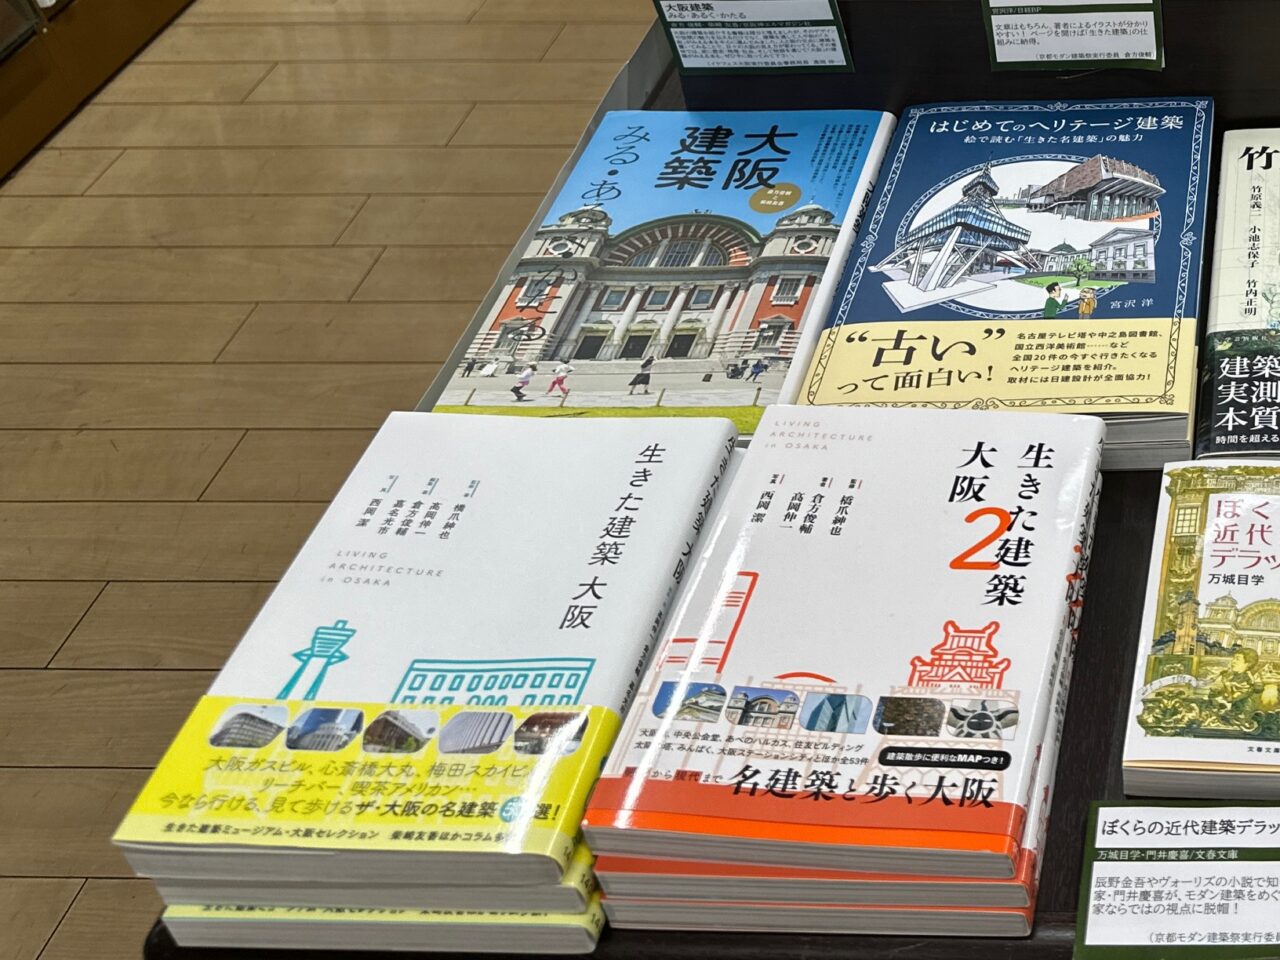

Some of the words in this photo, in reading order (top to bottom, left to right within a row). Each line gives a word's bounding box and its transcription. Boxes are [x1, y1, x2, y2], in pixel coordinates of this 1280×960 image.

[665, 2, 715, 12] 大阪建築
[929, 114, 1185, 135] はじめてのヘリテージ建築
[654, 126, 735, 191] 建築
[721, 124, 799, 191] 大阪
[769, 431, 874, 443] ARCHITECTURE
[773, 420, 822, 428] LIVING
[948, 440, 999, 504] 大阪
[588, 442, 667, 567] 生きた建築
[981, 442, 1056, 607] 生きた建築
[336, 550, 389, 560] LIVING
[948, 506, 1012, 571] 2
[328, 562, 445, 577] ARCHITECTURE
[1207, 573, 1265, 586] 万城目学
[558, 576, 608, 630] 大阪
[728, 763, 999, 809] 名建築と歩く大阪
